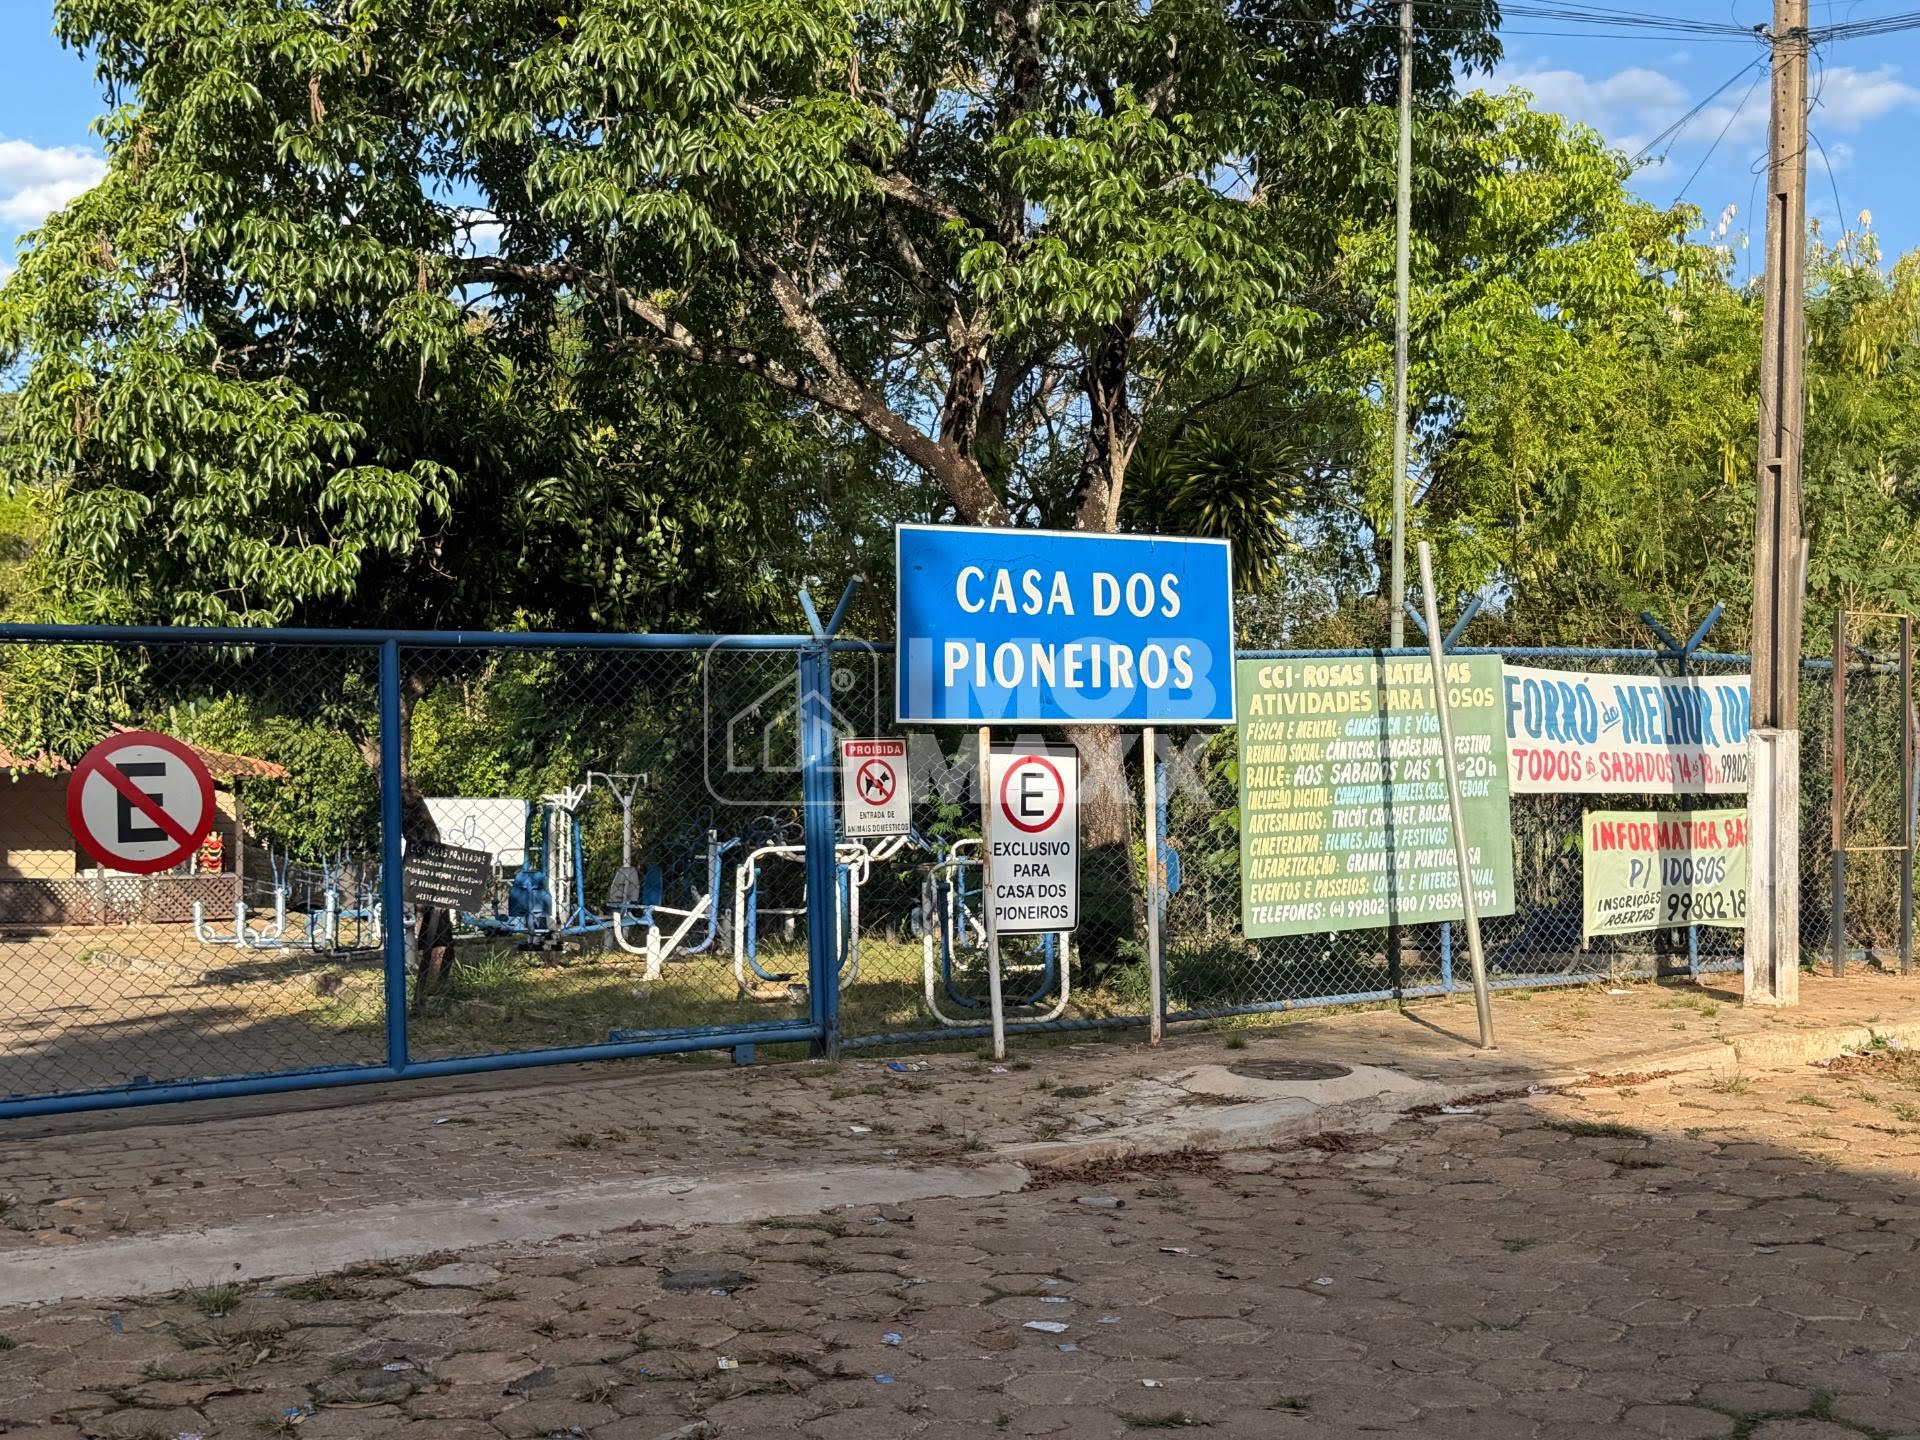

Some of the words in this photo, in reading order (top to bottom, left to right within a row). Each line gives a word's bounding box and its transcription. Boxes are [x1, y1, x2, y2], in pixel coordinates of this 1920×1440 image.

[956, 566, 1075, 616] CASA
[1093, 572, 1181, 618] DOS
[944, 641, 1193, 689] PIONEIROS
[1370, 663, 1471, 685] PRATEAAS
[1249, 690, 1372, 716] ATIVIDADES
[1379, 688, 1424, 710] PARA
[1430, 688, 1494, 709] IOSOS
[1504, 675, 1598, 745] FORRÓ
[1613, 685, 1720, 748] MELHOR
[1247, 719, 1284, 740] FÍSICA
[1287, 721, 1294, 739] E
[1296, 720, 1341, 740] MENTAL:
[1345, 714, 1400, 737] GINÁSTICA
[1405, 715, 1412, 734] E
[850, 745, 901, 755] PROIBIDA
[1246, 742, 1287, 764] REUNIÃO
[1289, 743, 1324, 762] SOCIAL:
[1246, 766, 1290, 789] BAILE:
[1293, 764, 1323, 787] AOS
[1330, 760, 1399, 784] SÁBADOS
[1403, 759, 1431, 781] DAS
[1435, 757, 1445, 779] 1
[1512, 749, 1581, 782] TODOS
[1599, 752, 1675, 784] SABADOS
[1676, 753, 1691, 783] 14
[116, 762, 168, 843] E
[1021, 773, 1044, 816] E
[1247, 787, 1291, 810] INCLUSÃO
[1293, 788, 1333, 809] DIGITAL:
[860, 811, 885, 819] ENTRADA
[1249, 811, 1327, 834] ARTESANATOS:
[847, 824, 871, 833] ANIMAIS
[1724, 818, 1747, 849] BA
[993, 841, 1070, 857] EXCLUSIVO
[1249, 834, 1323, 856] CINETERAPIA:
[1365, 830, 1399, 850] JOGOS
[1401, 827, 1448, 846] FESTIVOS
[1014, 864, 1050, 877] PARA
[1249, 852, 1340, 880] ALFABETIZAÇÃO:
[1629, 857, 1651, 889] P/
[1662, 855, 1725, 886] IDOSOS
[996, 884, 1035, 899] CASA
[1038, 884, 1067, 898] DOS
[1250, 881, 1300, 903] EVENTOS
[1304, 881, 1312, 898] E
[1314, 877, 1369, 898] PASSEIOS:
[1373, 873, 1404, 894] LOCAL
[1409, 874, 1416, 891] E
[995, 905, 1069, 920] PIONEIROS
[1251, 902, 1326, 925] TELEFONES:
[1598, 891, 1661, 912] INSCRIÇÕES
[1605, 907, 1655, 927] ABERTAS
